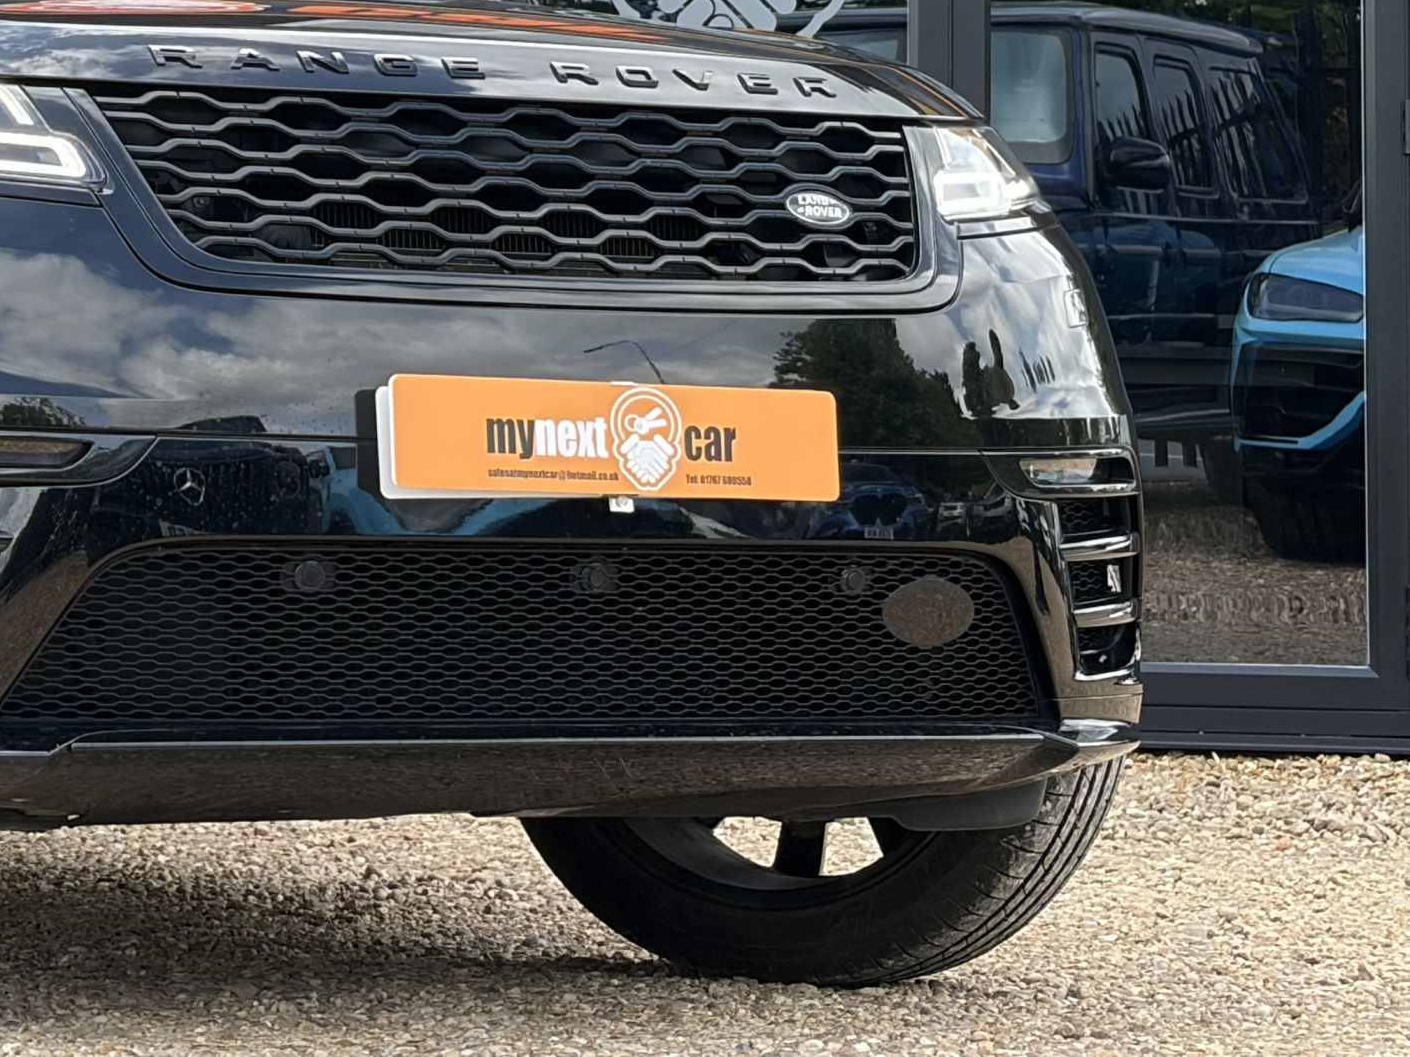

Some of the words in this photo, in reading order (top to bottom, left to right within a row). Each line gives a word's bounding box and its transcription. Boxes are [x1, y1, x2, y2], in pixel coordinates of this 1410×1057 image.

[147, 44, 486, 79] RANGE
[549, 61, 837, 98] ROVER
[798, 194, 829, 205] LAND
[805, 206, 842, 218] ROVER
[684, 426, 736, 462] car
